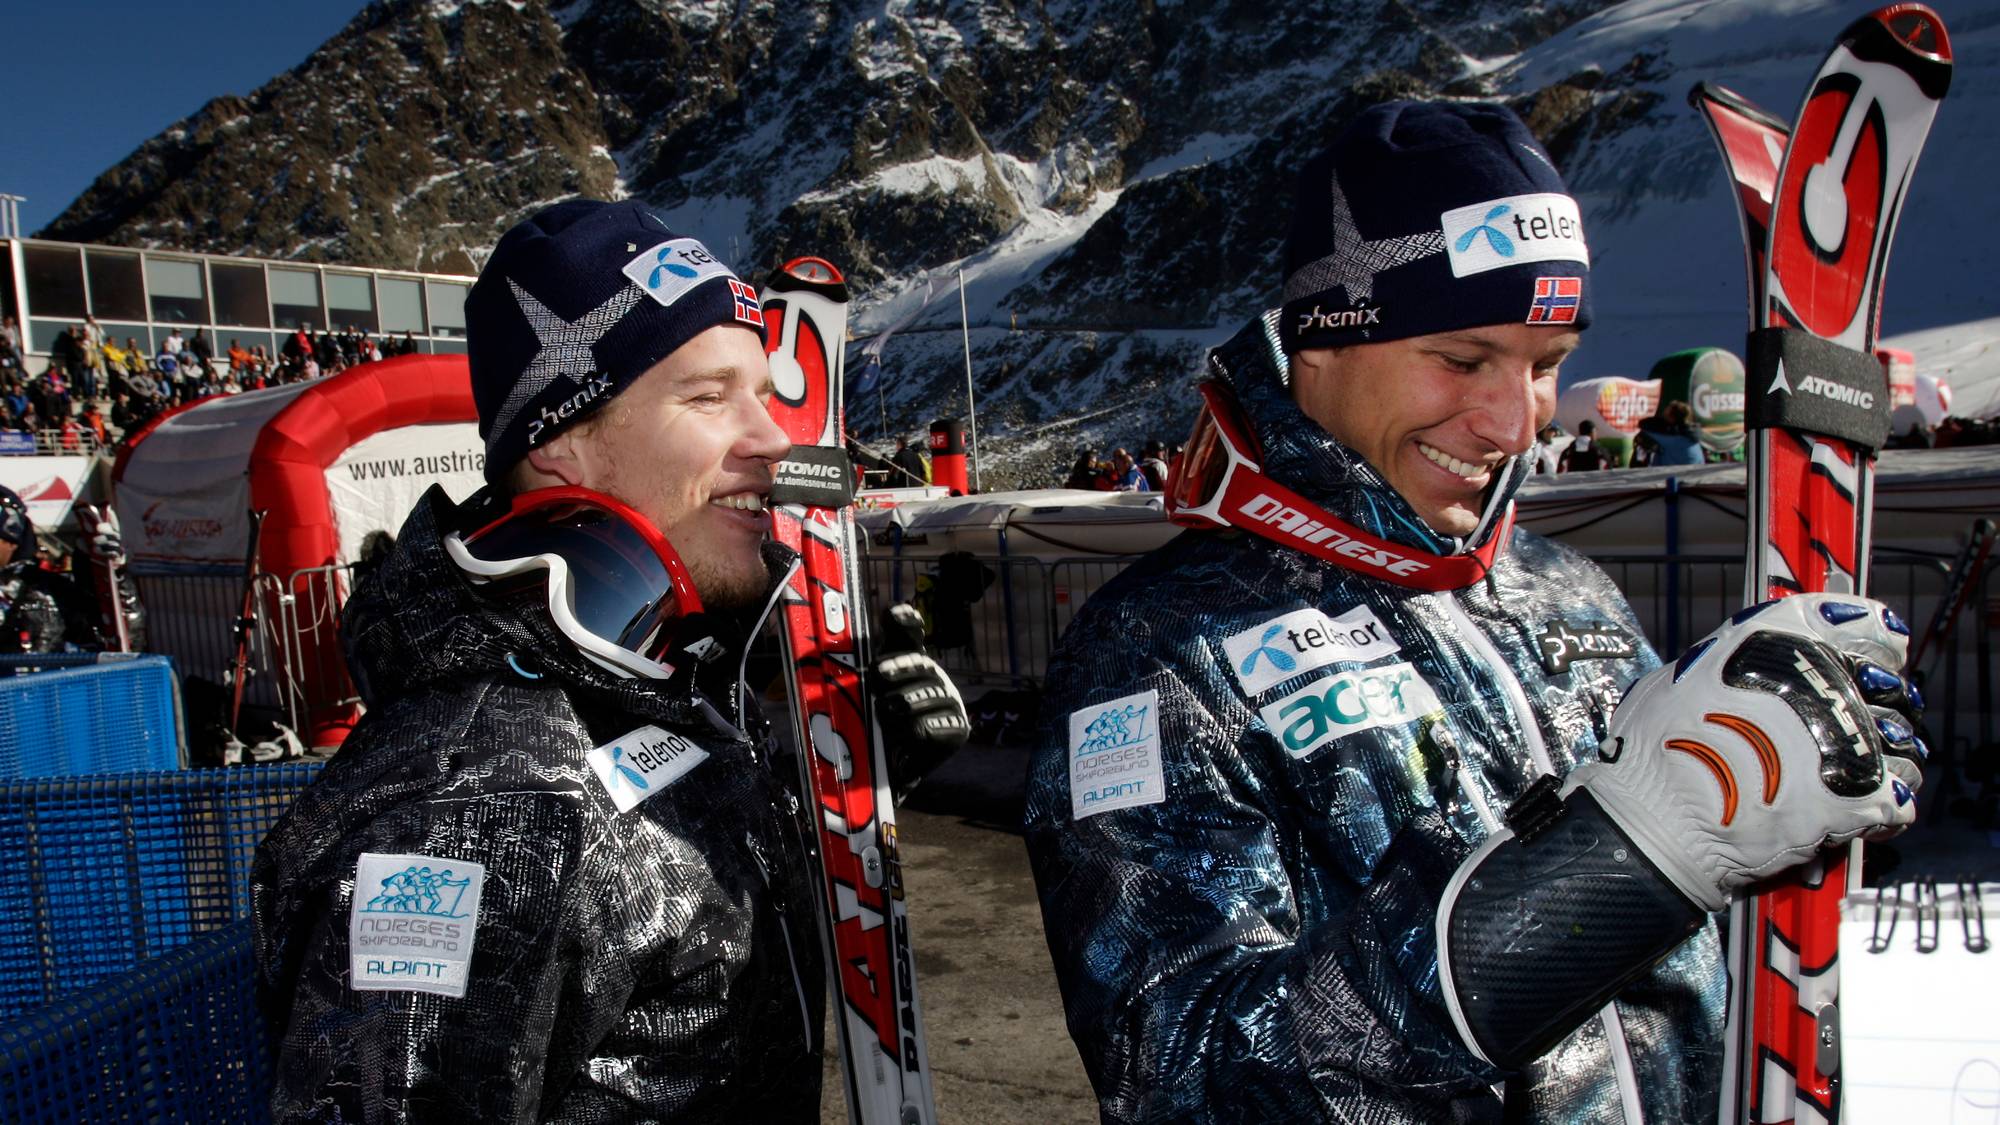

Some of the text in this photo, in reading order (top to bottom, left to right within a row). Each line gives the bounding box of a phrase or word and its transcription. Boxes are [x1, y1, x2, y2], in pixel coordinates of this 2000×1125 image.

[1298, 303, 1381, 335] phenix
[1797, 375, 1875, 410] ATOMIC
[528, 371, 613, 445] phenix
[348, 449, 485, 480] www.austria
[776, 460, 841, 479] TOMIC
[1287, 619, 1382, 653] telenor
[1279, 669, 1412, 751] acer
[1075, 745, 1149, 772] NORGES
[1083, 780, 1146, 804] ALPINT
[359, 935, 459, 951] SKIFORBUND
[360, 918, 461, 939] NORGES
[367, 960, 448, 978] ALPINT
